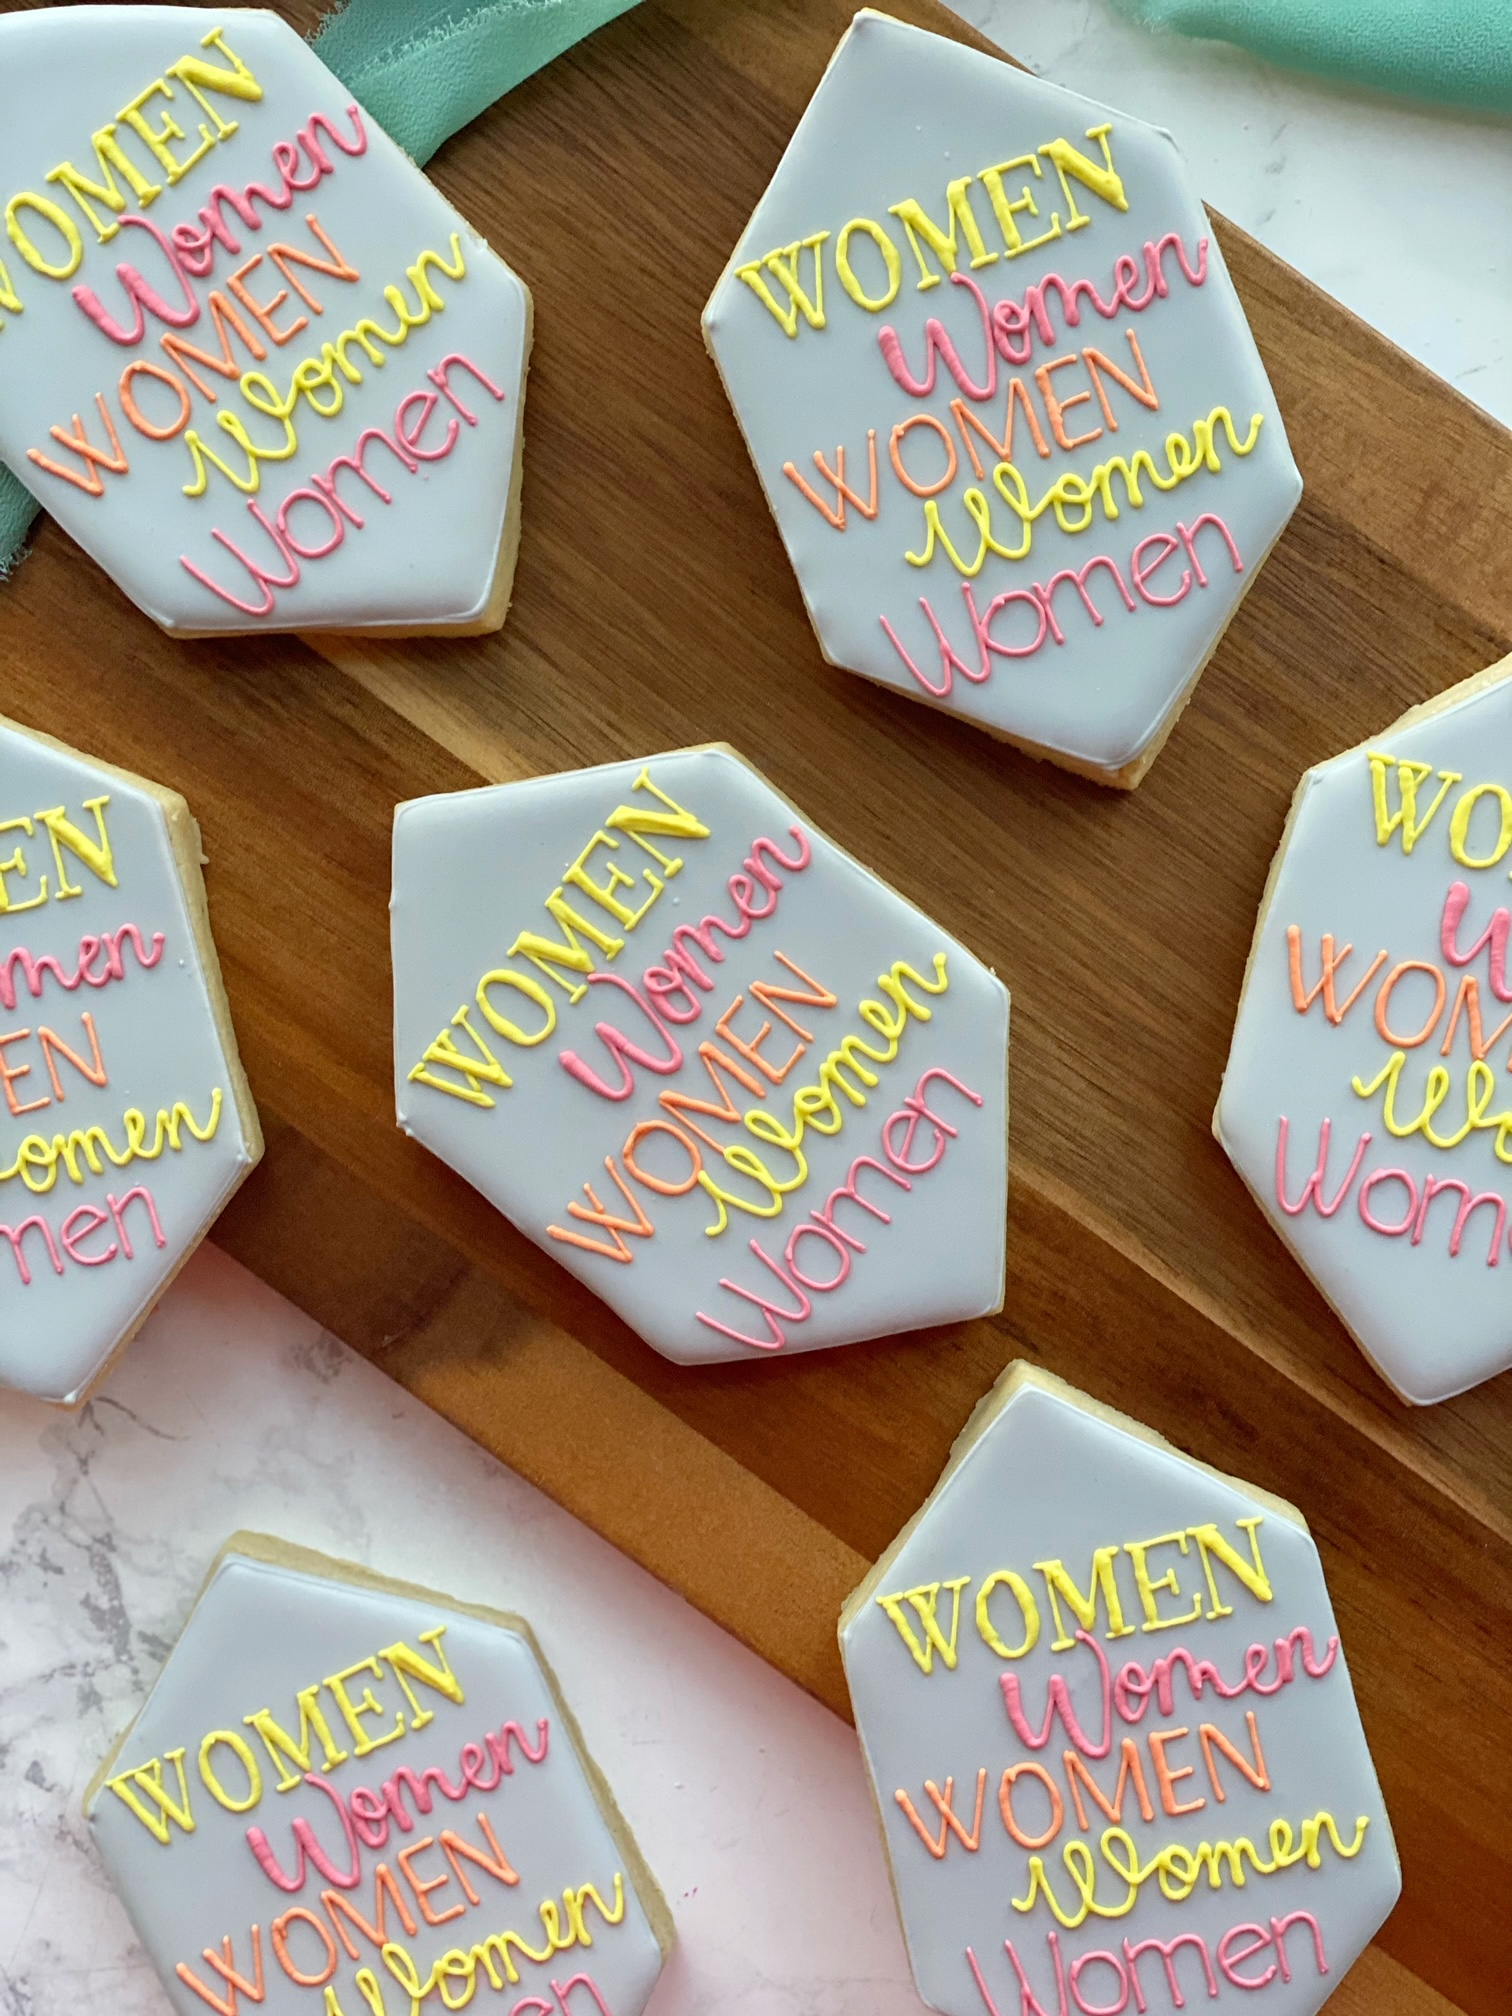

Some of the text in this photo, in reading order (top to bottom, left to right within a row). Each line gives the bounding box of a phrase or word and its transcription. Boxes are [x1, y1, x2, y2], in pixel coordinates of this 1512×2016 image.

[0, 29, 263, 330] OMEN
[73, 106, 367, 346] Women
[735, 125, 1128, 339] WOMEN
[28, 217, 359, 496] WOMEN
[185, 236, 466, 498] Women
[879, 235, 1208, 402] Women
[181, 356, 504, 617] Women
[784, 332, 1158, 532] WOMEN
[906, 408, 1263, 579] Women
[881, 516, 1243, 698] Women
[408, 768, 710, 1109] WOMEN
[560, 827, 811, 1103] Women
[547, 954, 837, 1264] WOMEN
[699, 954, 949, 1238] Women
[696, 1071, 983, 1351] Women
[877, 1519, 1273, 1675] WOMEN
[999, 1628, 1339, 1761] Women
[108, 1627, 464, 1845] WOMEN
[246, 1719, 548, 1894] Women
[896, 1715, 1270, 1859] WOMEN
[176, 1817, 520, 2016] WOMEN
[967, 1915, 1328, 2016] Women
[1013, 1812, 1369, 1928] Women
